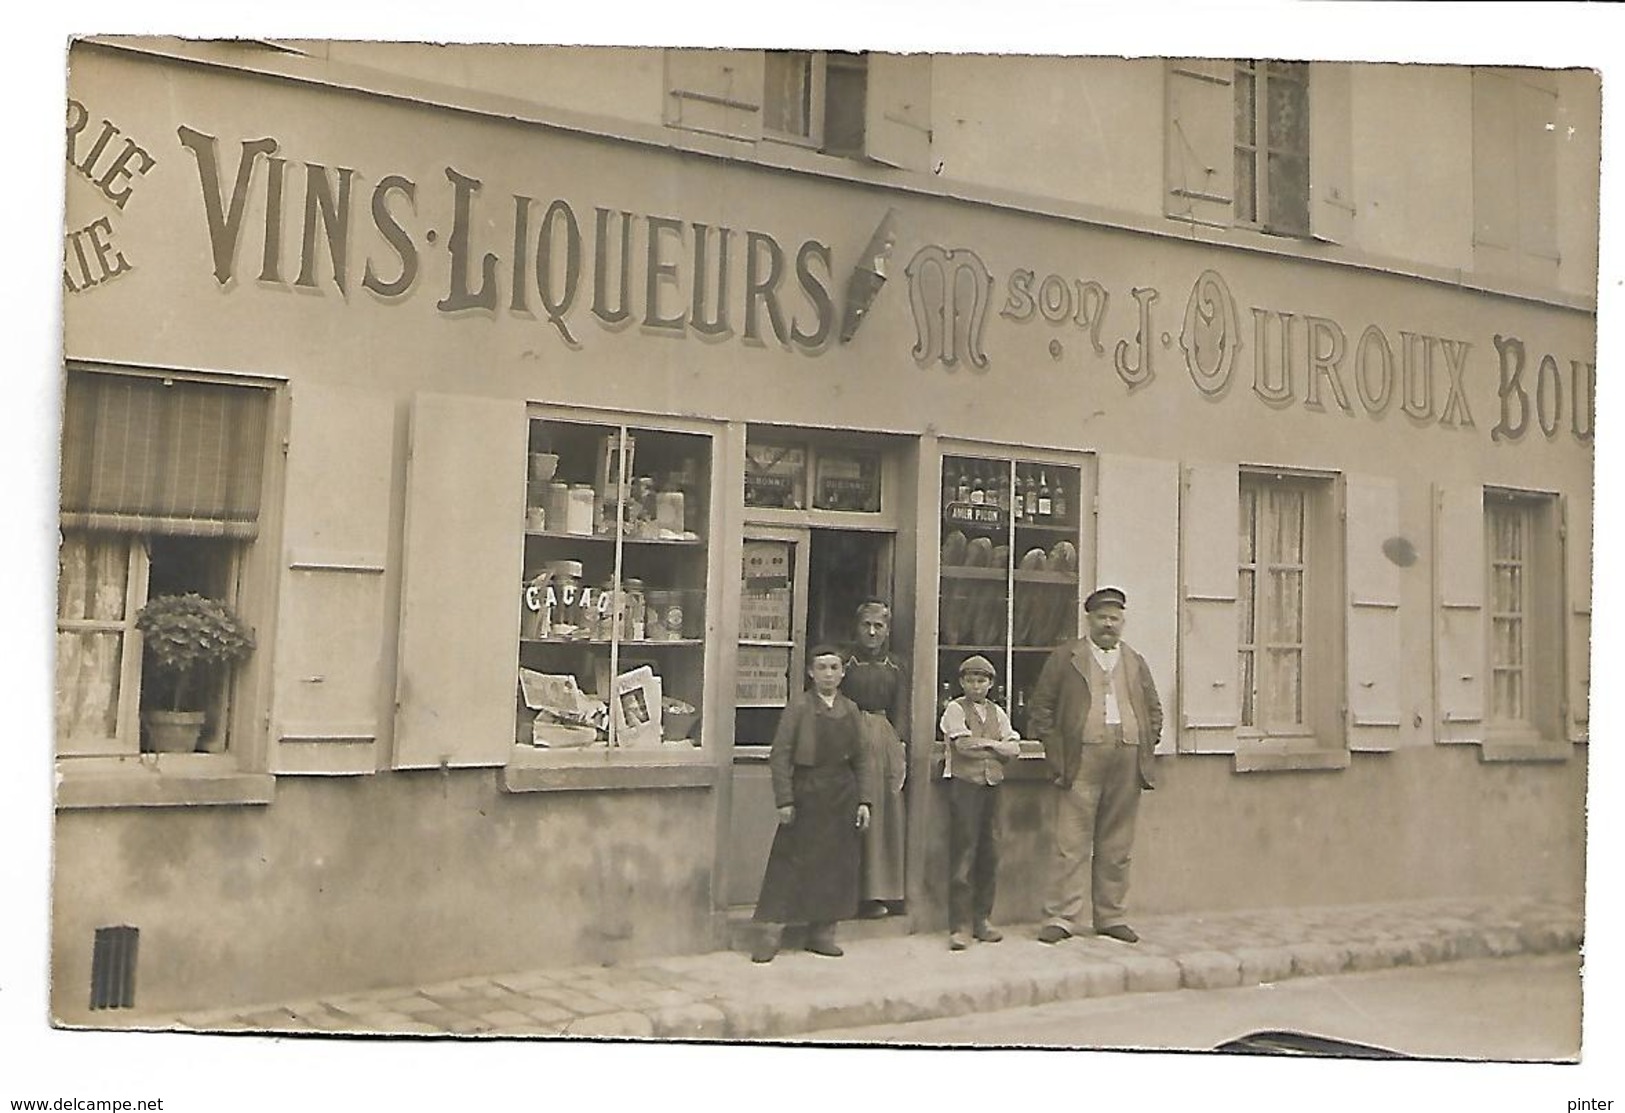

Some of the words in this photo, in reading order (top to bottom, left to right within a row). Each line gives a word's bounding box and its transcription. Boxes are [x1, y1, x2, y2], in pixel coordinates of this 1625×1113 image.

[66, 98, 157, 210] RIE
[177, 124, 419, 304] VINS
[437, 166, 832, 351] LIQUEURS
[1179, 268, 1478, 430] OUROUX
[1490, 333, 1595, 442] BOU
[526, 586, 609, 612] CACAO
